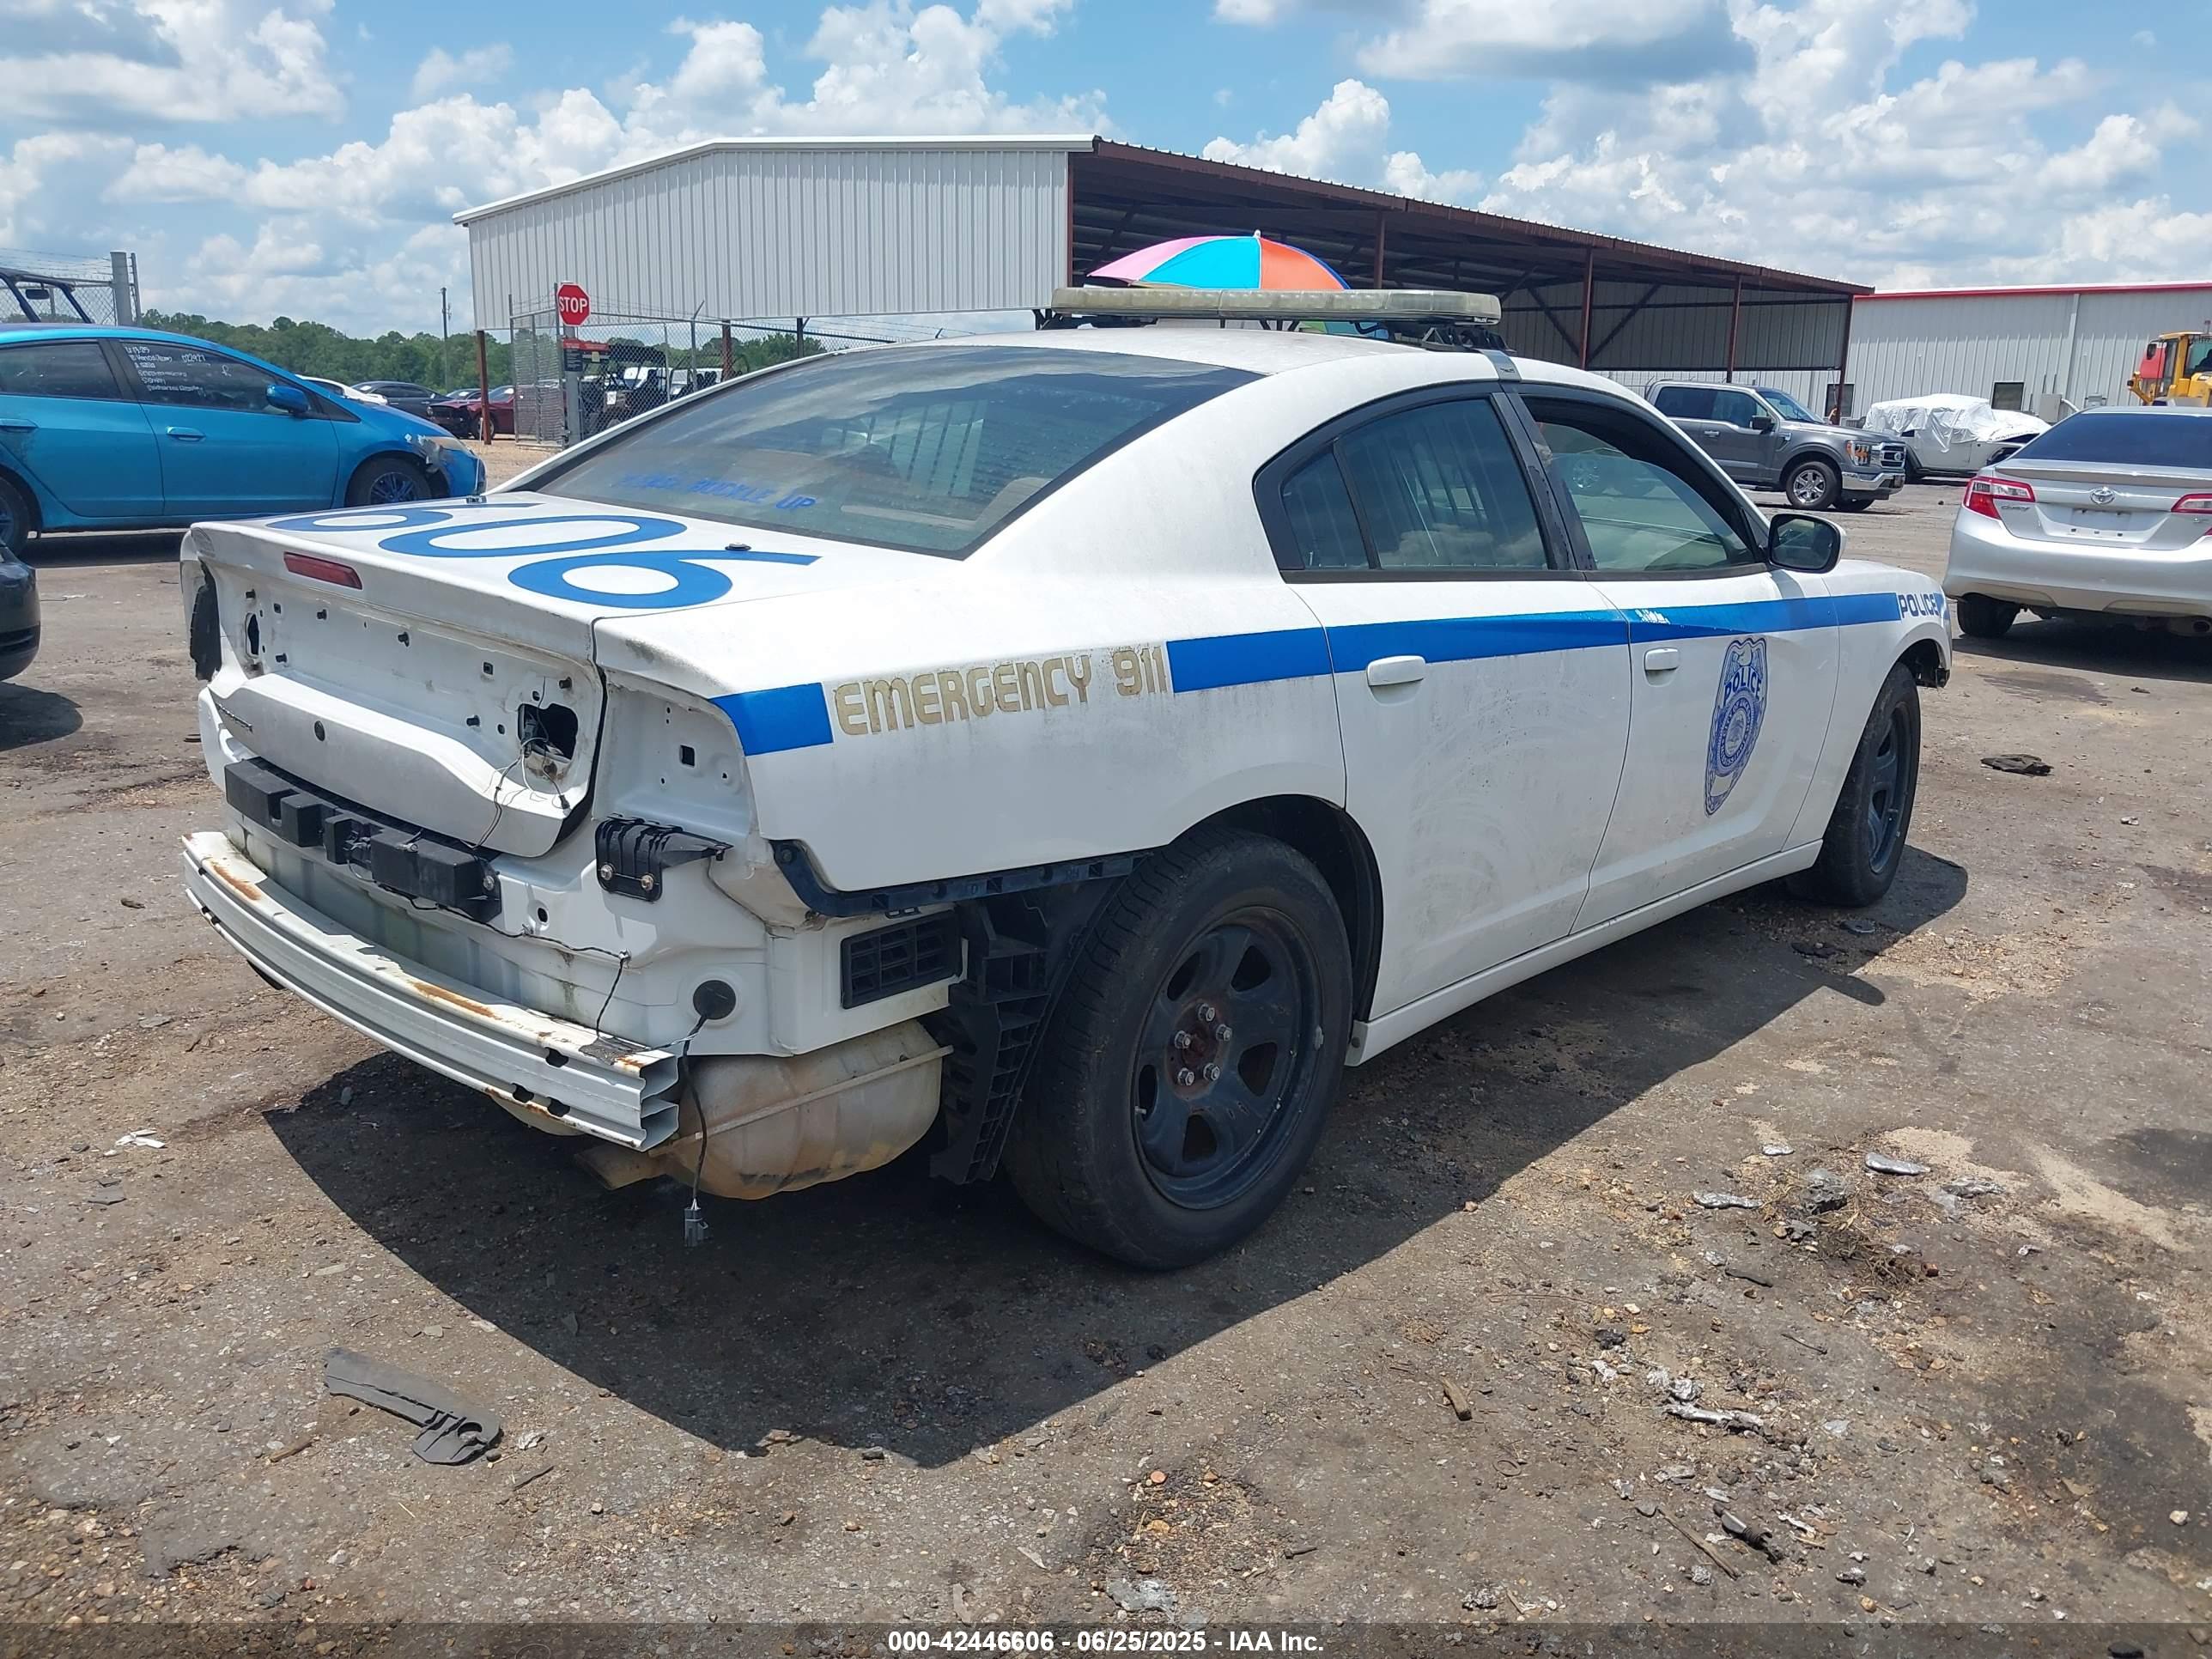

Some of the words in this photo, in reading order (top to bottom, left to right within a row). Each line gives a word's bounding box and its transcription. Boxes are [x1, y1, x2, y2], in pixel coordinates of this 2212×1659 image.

[558, 295, 588, 313] STOP
[775, 494, 817, 510] UP
[1898, 592, 1940, 618] POLICE
[834, 654, 1092, 736] EMERGENCY
[1112, 647, 1169, 697] 911
[1723, 666, 1762, 707] POLICE
